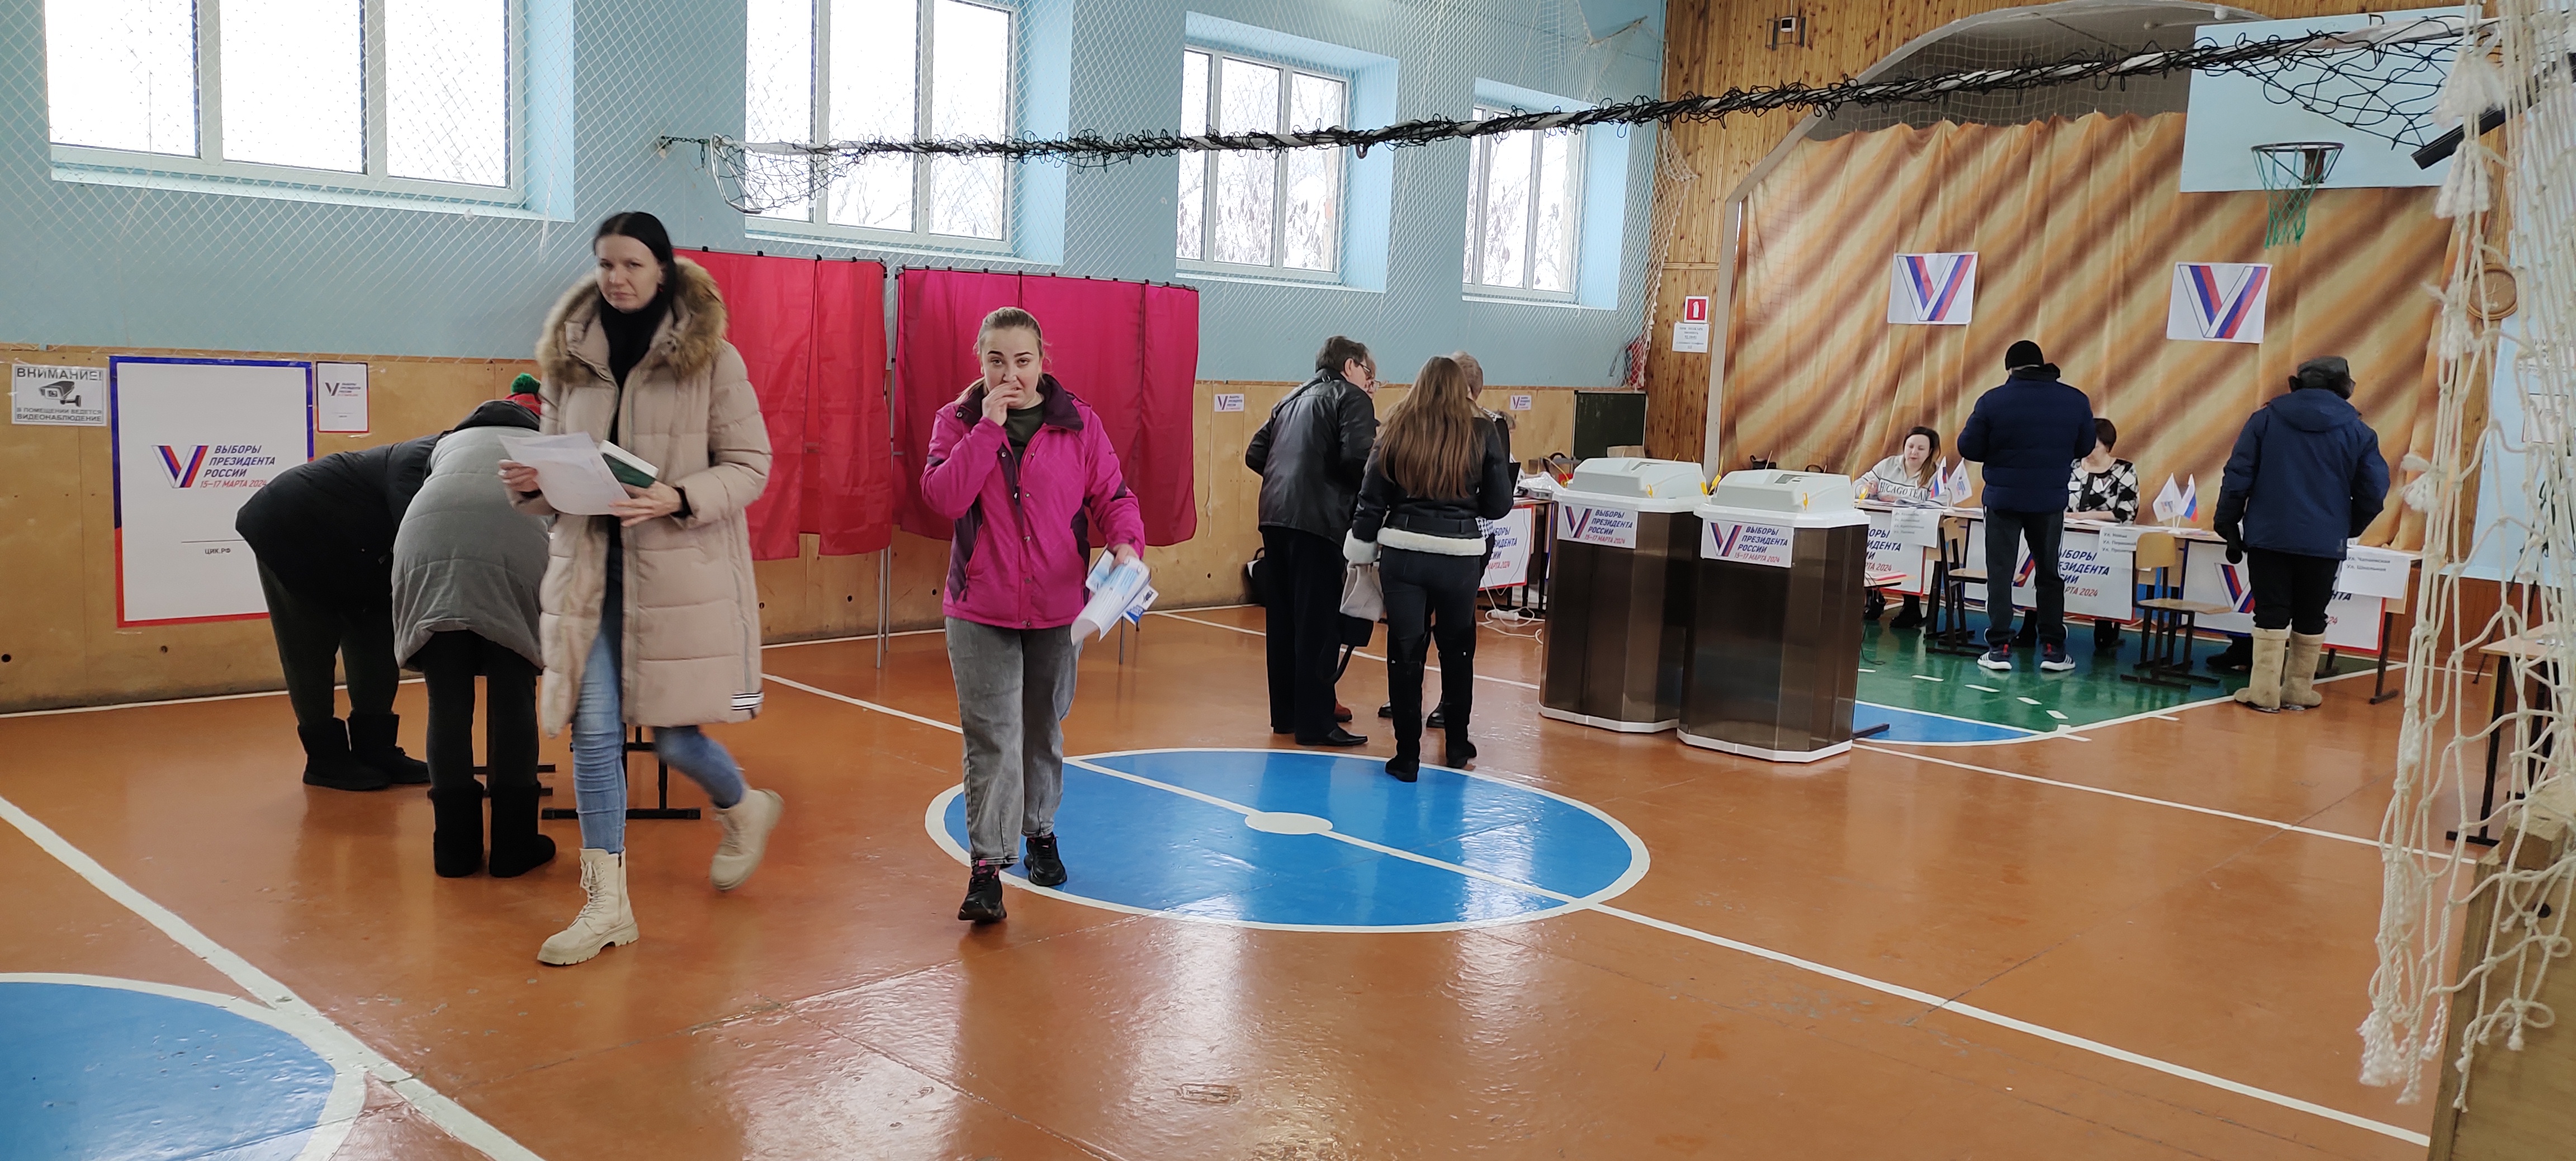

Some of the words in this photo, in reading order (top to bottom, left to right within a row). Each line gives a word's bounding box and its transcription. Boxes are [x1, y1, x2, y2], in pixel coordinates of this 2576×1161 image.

[17, 367, 102, 381] ВНИМАНИЕ!
[214, 445, 262, 454] ВЫБОРЫ
[209, 457, 276, 467] ПРЕЗИДЕНТА
[203, 469, 248, 478] РОССИИ
[249, 479, 267, 488] 2024
[1595, 509, 1625, 519] ВЫБОРЫ
[1591, 518, 1633, 528] ПРЕЗИДЕНТА
[1588, 526, 1614, 535] РОССИИ
[1746, 526, 1779, 536] ВЫБОРЫ
[1741, 535, 1788, 546] ПРЕЗИДЕНТА
[1737, 544, 1768, 553] РОССИИ
[2062, 549, 2097, 561] БОРЫ
[1876, 563, 1892, 572] 2024
[2064, 586, 2078, 595] РТА
[2080, 588, 2099, 597] 2024
